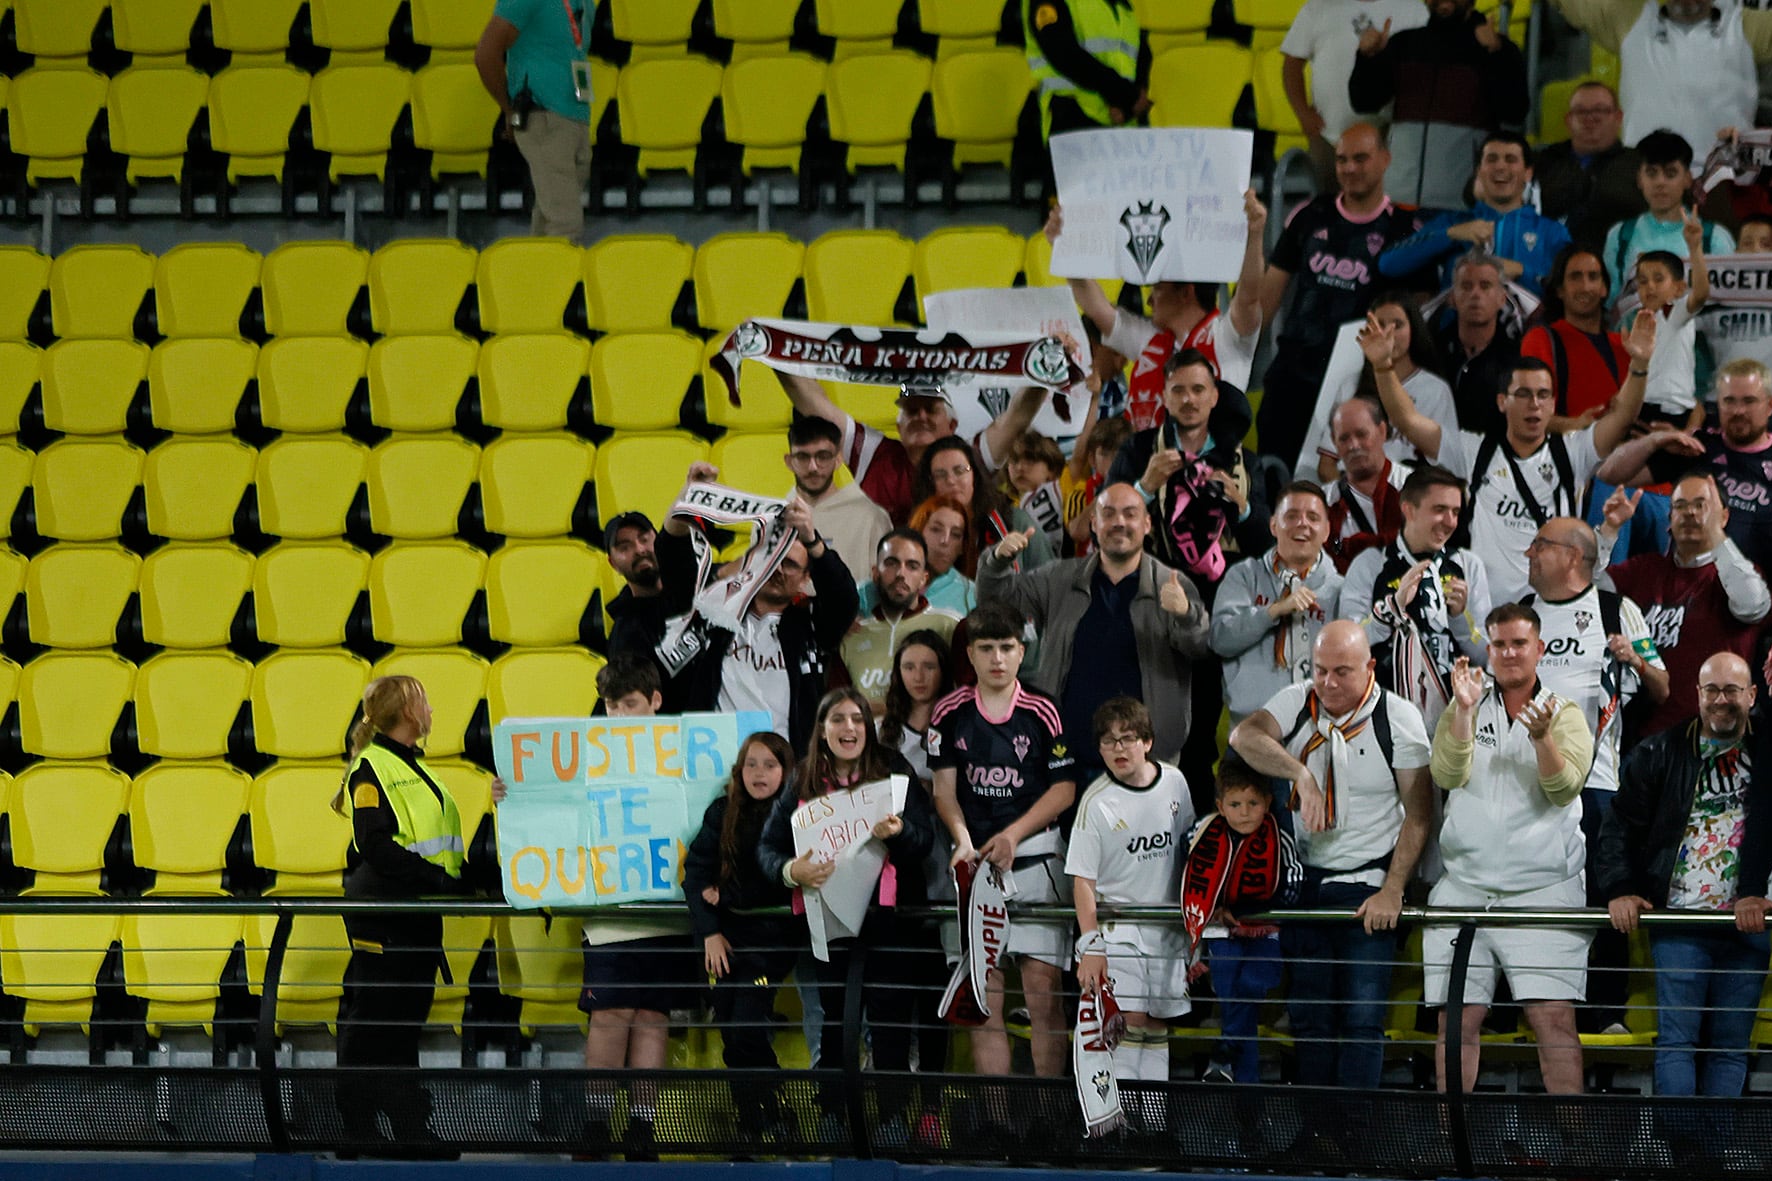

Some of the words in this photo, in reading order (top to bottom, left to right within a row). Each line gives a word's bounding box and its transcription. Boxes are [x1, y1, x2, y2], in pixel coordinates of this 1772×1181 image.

[780, 338, 863, 366] PEÑA
[873, 347, 1011, 370] K'TOMAS
[510, 725, 723, 784] FUSTER
[587, 786, 653, 840] TE
